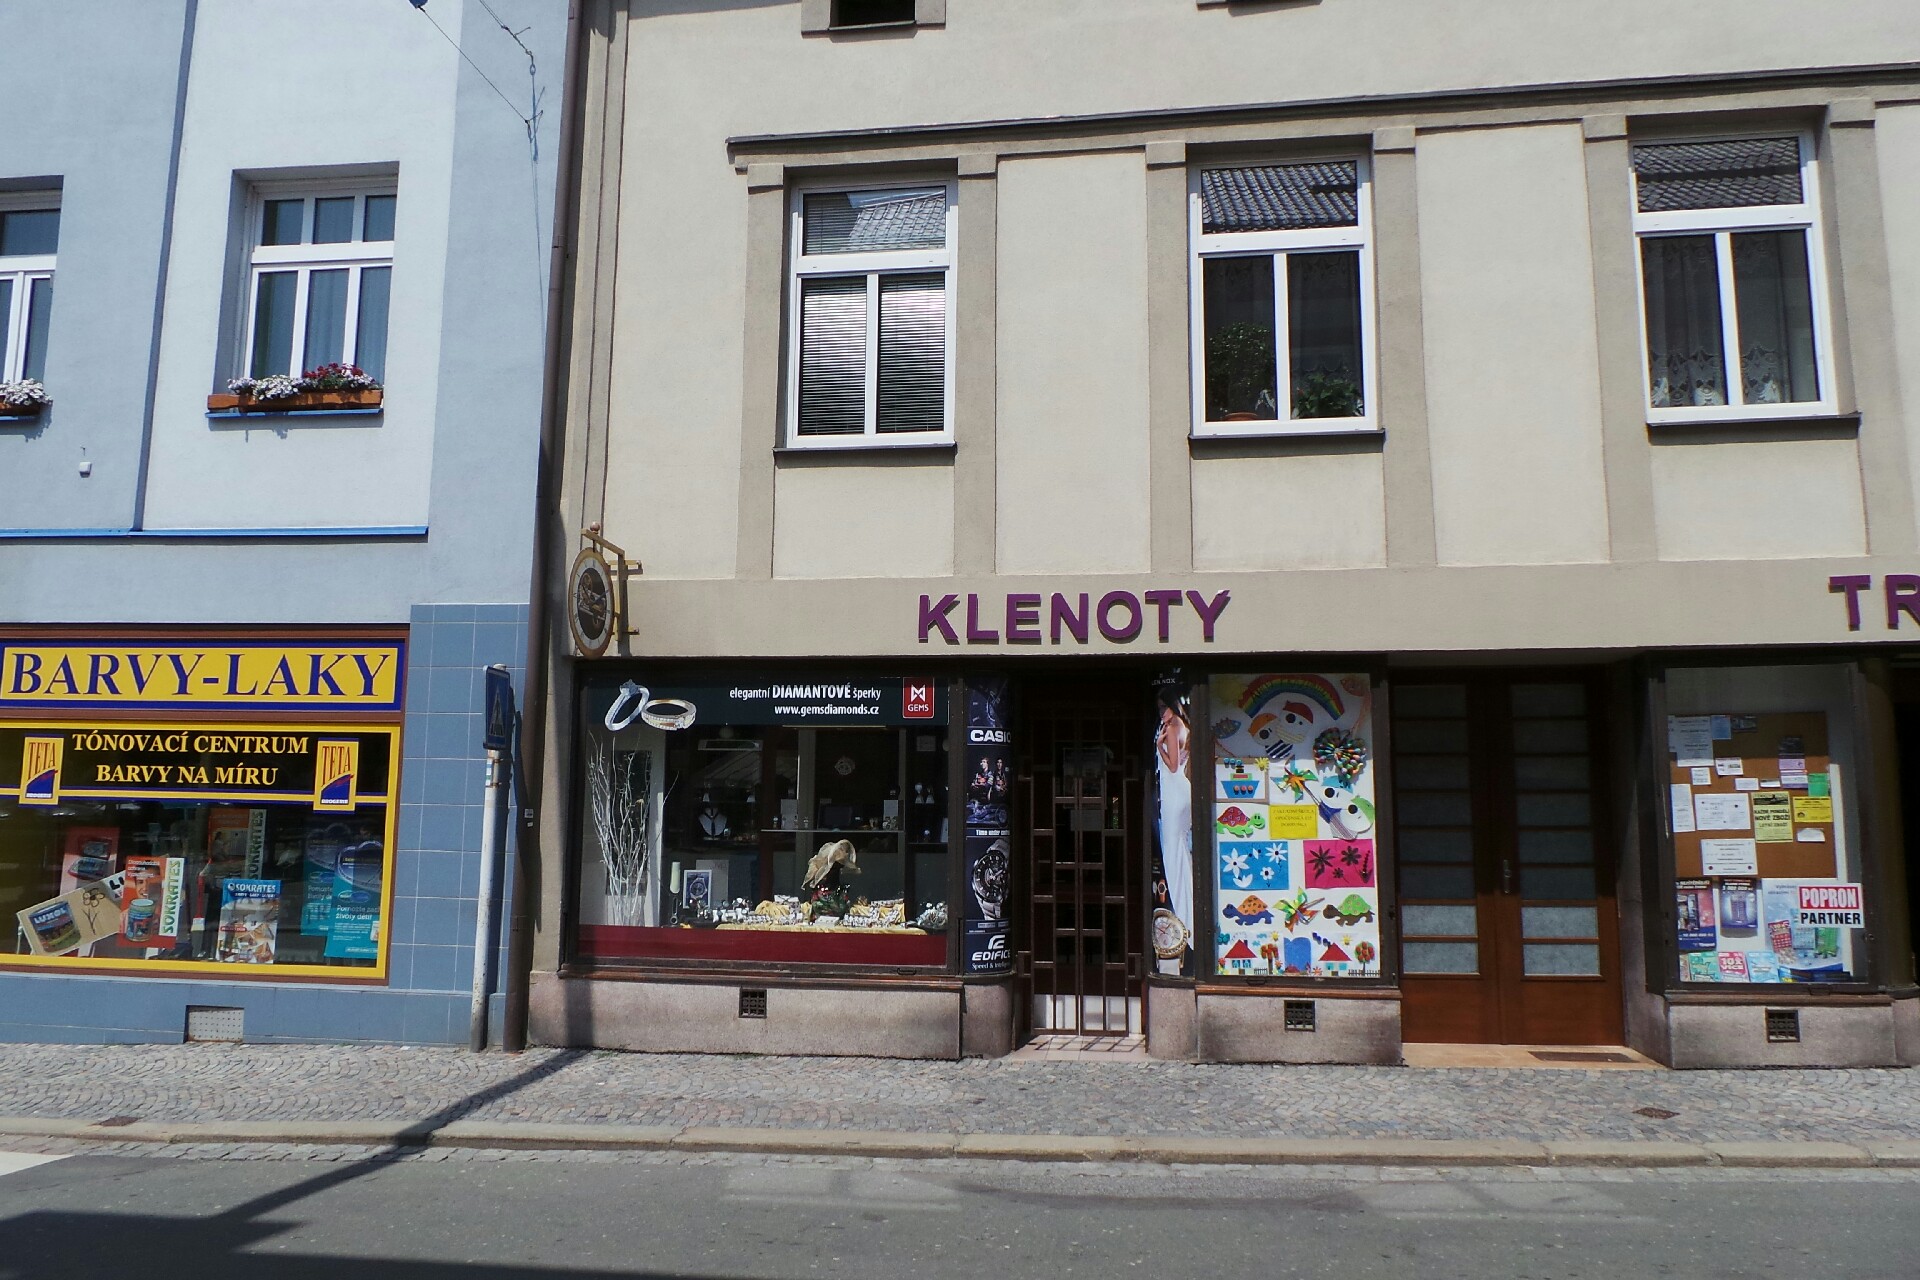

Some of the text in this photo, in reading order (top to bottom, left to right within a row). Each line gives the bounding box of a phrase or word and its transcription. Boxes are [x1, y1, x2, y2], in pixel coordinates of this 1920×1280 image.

[918, 589, 1230, 641] KLENOTY
[8, 653, 391, 697] BARVY-LAKY
[729, 682, 881, 700] elegantní DIAMANTOVÉ šperky
[774, 703, 880, 717] www.gemsdiamonds.cz
[908, 704, 929, 712] GEMS
[72, 730, 309, 754] TÓNOVACÍ CENTRUM
[970, 729, 1012, 743] CASIO
[28, 742, 56, 780] TETA
[322, 746, 351, 786] TETA
[95, 762, 279, 785] BARVY NA MÍRU
[162, 860, 181, 934] SOKRATES
[235, 883, 276, 893] SOKRATES
[1801, 888, 1857, 908] POPRON
[1801, 912, 1861, 925] PARTNER
